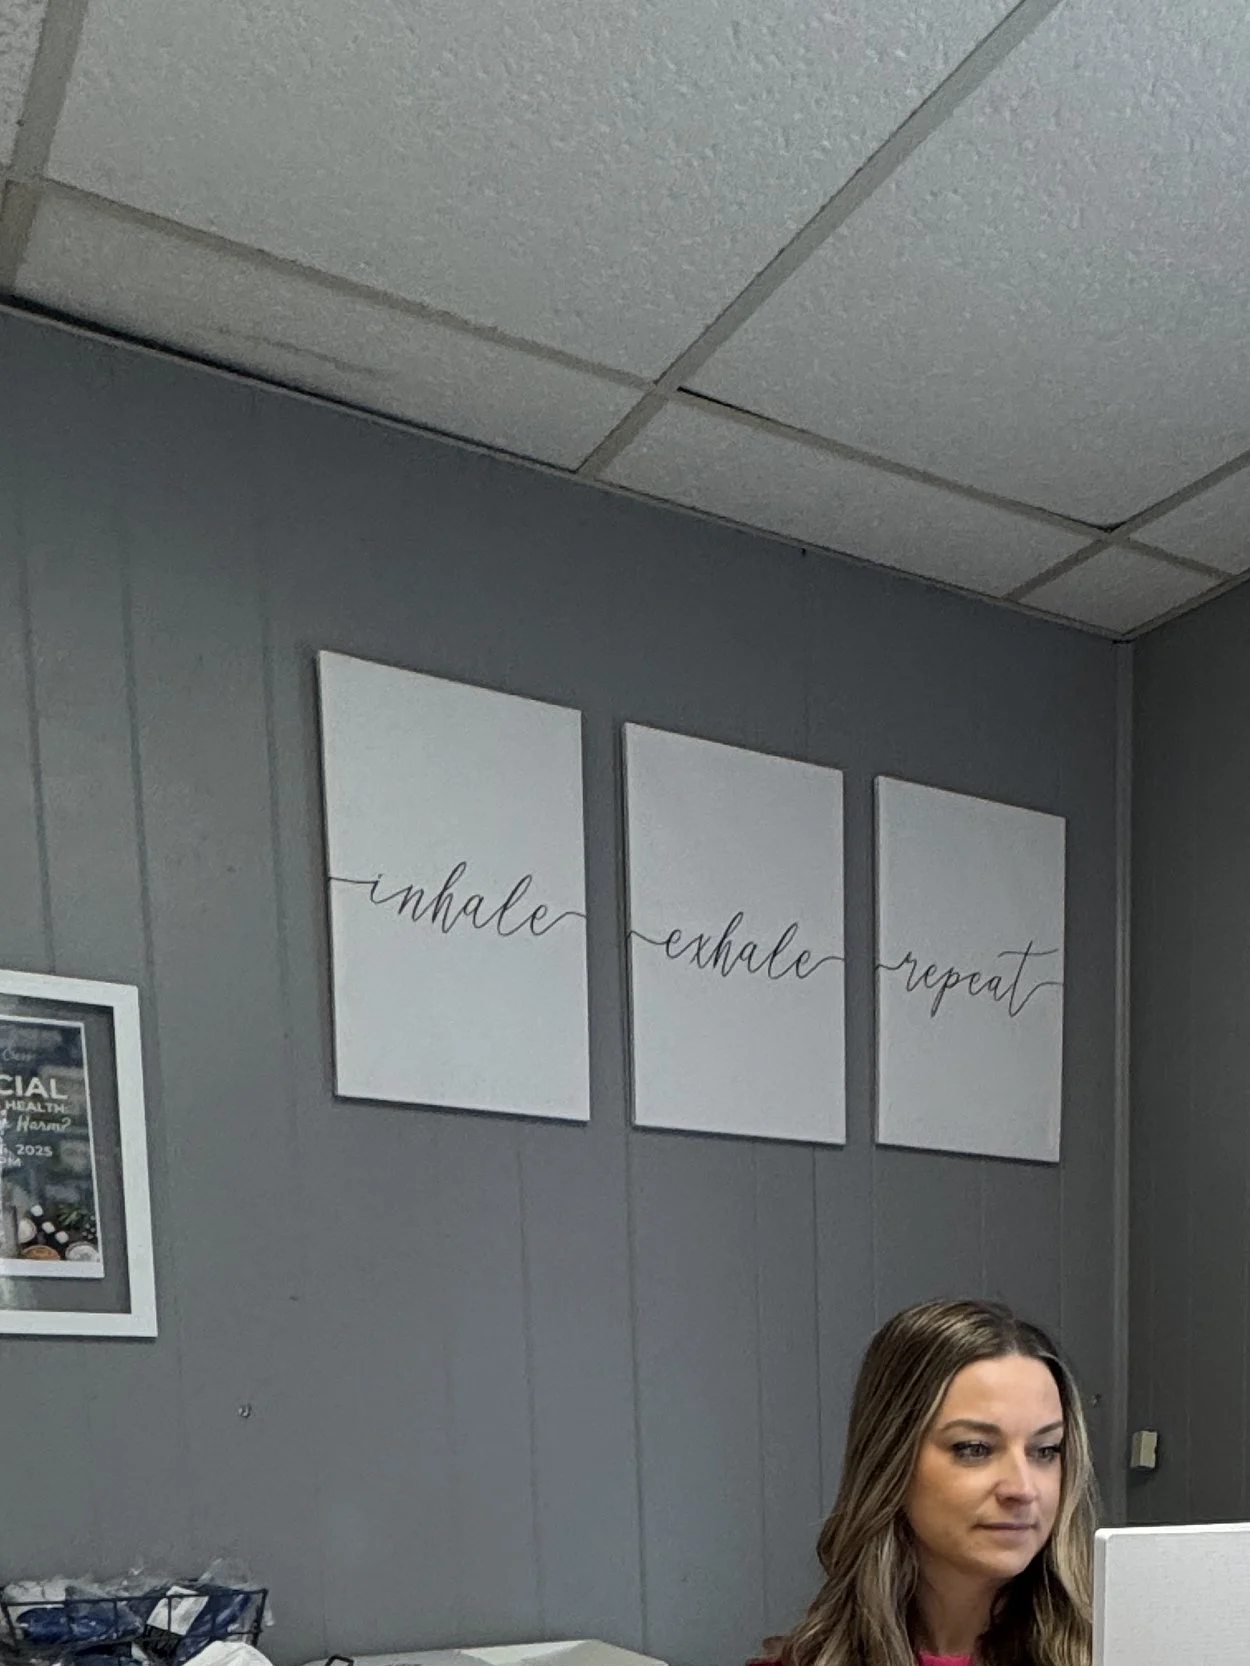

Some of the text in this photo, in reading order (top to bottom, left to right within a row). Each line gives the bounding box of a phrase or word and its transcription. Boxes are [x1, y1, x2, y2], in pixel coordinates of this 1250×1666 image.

[328, 861, 587, 936] inhale
[628, 911, 844, 979] exhale
[878, 940, 1064, 1017] repeat
